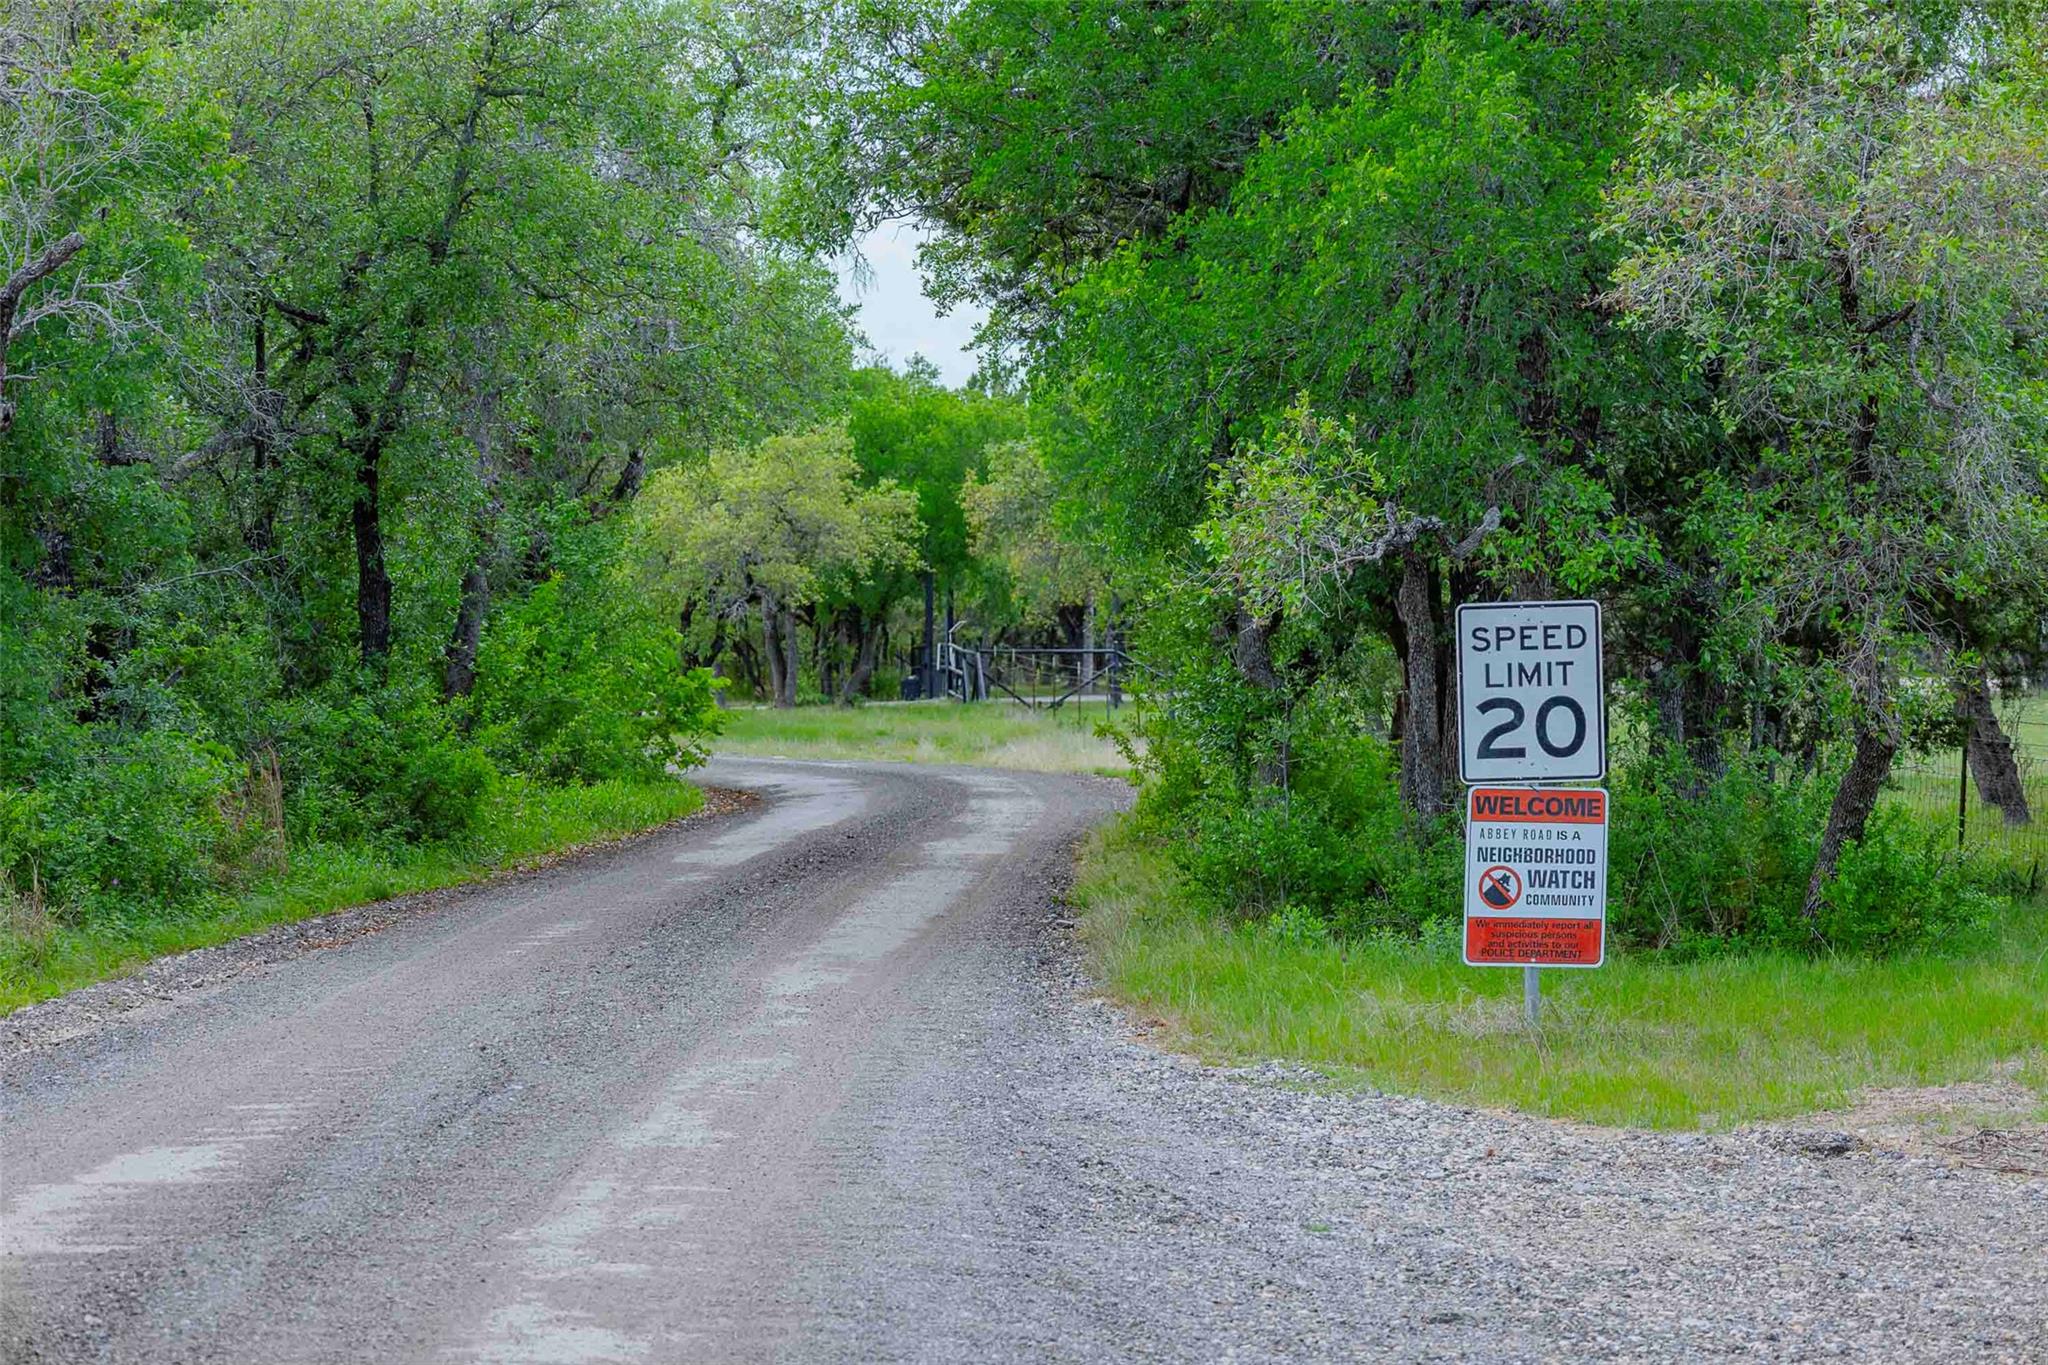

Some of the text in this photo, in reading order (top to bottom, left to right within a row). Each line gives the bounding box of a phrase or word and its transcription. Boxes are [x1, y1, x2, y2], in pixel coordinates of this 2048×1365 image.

[1472, 625, 1587, 652] SPEED
[1485, 661, 1574, 688] LIMIT
[1476, 696, 1586, 759] 20
[1475, 796, 1600, 817] WELCOME
[1480, 828, 1581, 840] ABBEY ROAD IS A
[1477, 847, 1596, 864] NEIGHBORHOOD
[1528, 870, 1595, 889] WATCH
[1526, 894, 1594, 906] COMMUNITY
[1475, 920, 1594, 930] We immediately report all
[1491, 930, 1577, 940] suspicious persons
[1488, 940, 1504, 948] and
[1507, 940, 1548, 948] activities
[1481, 948, 1582, 959] POLICE DEPARTMENT
